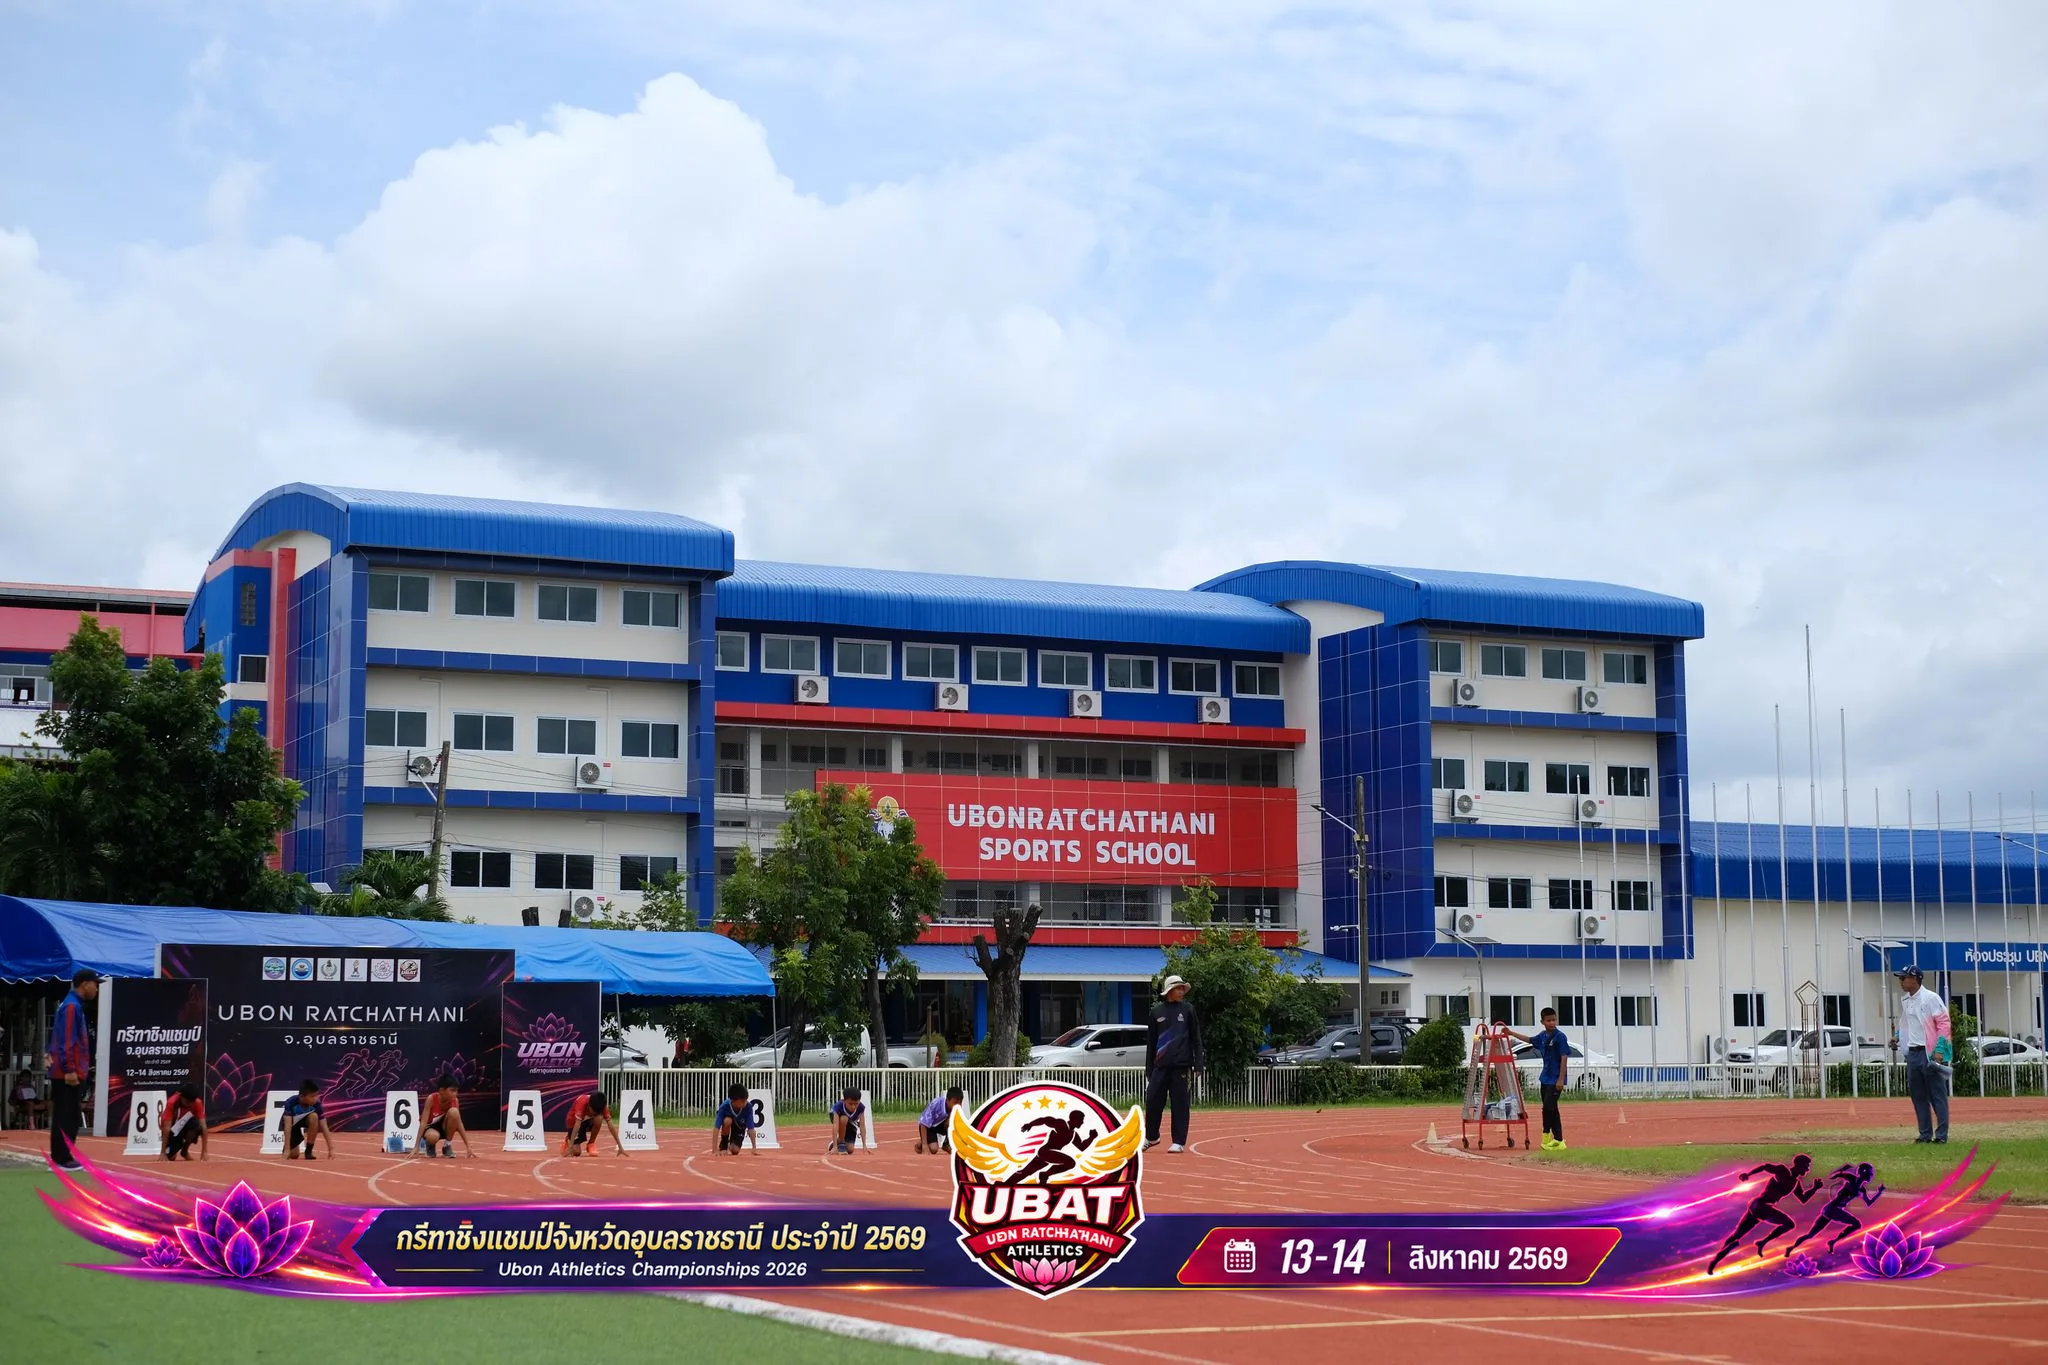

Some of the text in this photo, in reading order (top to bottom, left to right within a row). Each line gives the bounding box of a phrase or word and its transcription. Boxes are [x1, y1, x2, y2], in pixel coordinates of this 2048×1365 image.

[948, 804, 1215, 835] UBONRATCHATHANI
[979, 837, 1196, 866] SPORTS SCHOOL
[218, 1005, 465, 1022] UBON RATCHATHANI
[126, 1043, 189, 1058] จ.อุบลราชธานี
[284, 1032, 398, 1048] จ.อุบลราชธานี
[517, 1042, 587, 1058] UBON
[517, 1057, 584, 1067] ATHLETICS
[136, 1101, 148, 1133] 8
[393, 1099, 412, 1129] 6
[516, 1099, 534, 1130] 5
[627, 1099, 646, 1129] 4
[750, 1099, 765, 1128] 3
